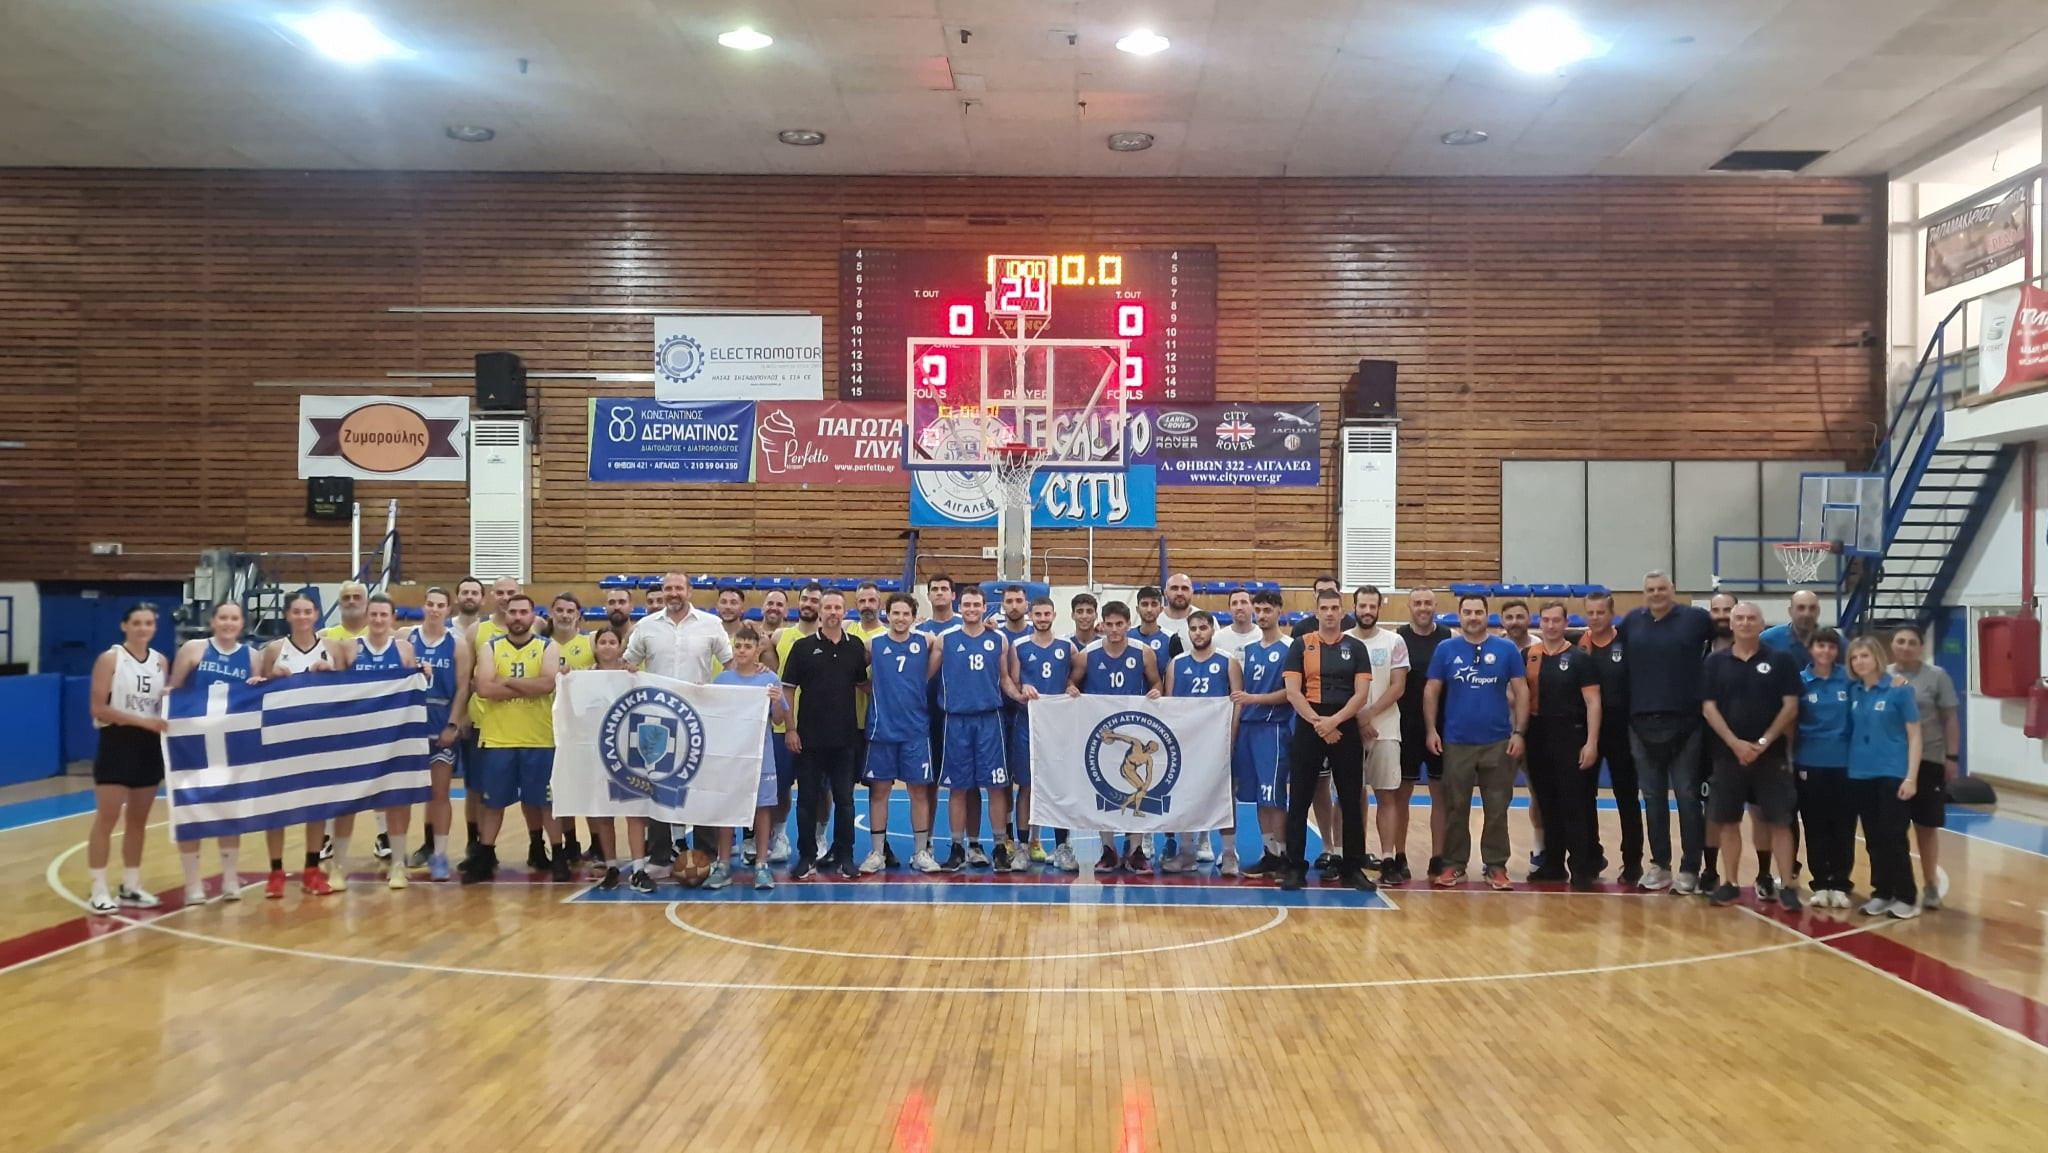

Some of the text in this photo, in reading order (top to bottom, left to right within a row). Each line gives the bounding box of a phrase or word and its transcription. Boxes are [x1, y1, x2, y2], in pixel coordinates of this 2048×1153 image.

[856, 250, 862, 258] 4
[1172, 252, 1178, 260] 4
[856, 262, 862, 270] 5
[1172, 264, 1178, 272] 5
[856, 275, 862, 283] 6
[1172, 277, 1178, 285] 6
[856, 287, 862, 296] 7
[923, 290, 939, 298] OUT
[1001, 277, 1046, 312] 24
[1124, 291, 1141, 299] OUT
[1171, 290, 1177, 298] 7
[856, 300, 862, 308] 8
[1171, 302, 1177, 310] 8
[856, 312, 862, 320] 9
[949, 305, 973, 335] 0
[1171, 314, 1177, 322] 9
[1118, 306, 1143, 336] 0
[851, 326, 862, 334] 10
[1166, 328, 1176, 336] 10
[1166, 340, 1176, 348] 11
[710, 347, 822, 360] ELECTROMOTOR
[851, 351, 862, 359] 12
[1165, 353, 1176, 361] 12
[851, 363, 862, 371] 13
[1165, 365, 1176, 373] 13
[851, 376, 862, 384] 14
[1165, 378, 1176, 386] 14
[851, 388, 862, 396] 15
[1165, 390, 1176, 398] 15
[641, 410, 703, 420] ΚΩΝΣΤΑΝΤΙΝΟΣ
[1223, 411, 1249, 421] CITY
[344, 429, 425, 446] Ζυμαρούλης
[641, 424, 739, 442] ΔΕΡΜΑΤΙΝΟΣ
[1216, 438, 1256, 451] ROVER
[784, 439, 829, 468] Perfetto
[1176, 461, 1223, 471] ΘΗΒΩΝ
[1225, 461, 1245, 471] 322
[1255, 461, 1312, 471] ΑΙΓΑΛΕΩ
[1190, 472, 1282, 485] www.cityrover.gr
[1046, 472, 1130, 523] CITY
[896, 656, 906, 672] 7
[968, 654, 984, 670] 18
[198, 660, 247, 680] HELLAS
[511, 662, 525, 678] 33
[1042, 661, 1052, 678] 8
[137, 675, 151, 693] 15
[1109, 671, 1124, 688] 10
[1191, 677, 1209, 693] 23
[604, 691, 702, 780] ΕΛΛΗΝΙΚΗ ΑΣΤΥΝΟΜΙΑ
[922, 763, 930, 779] 7
[992, 767, 1006, 784] 18
